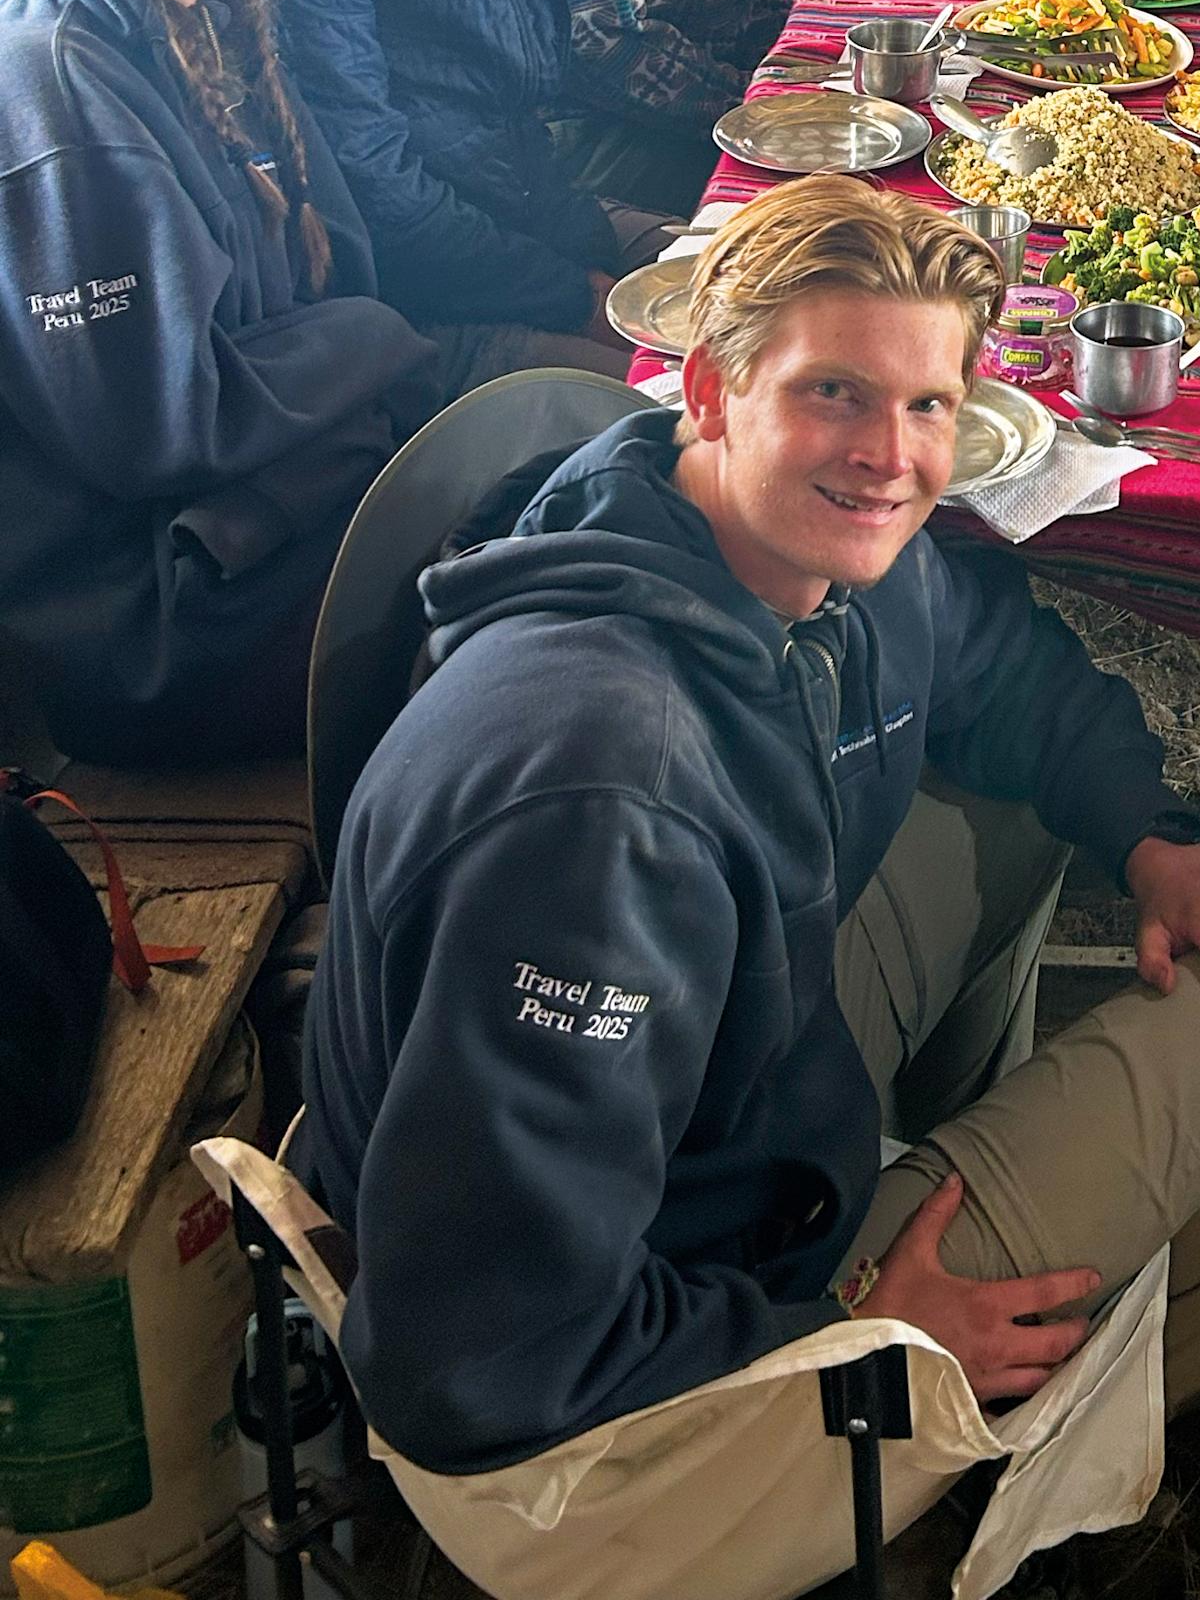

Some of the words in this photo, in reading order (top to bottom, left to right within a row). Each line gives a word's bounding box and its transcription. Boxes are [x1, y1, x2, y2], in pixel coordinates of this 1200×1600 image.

[25, 285, 81, 314] Travel
[86, 274, 138, 299] Team
[43, 312, 85, 331] Peru
[89, 294, 131, 320] 2025
[1003, 349, 1040, 364] COMPASS
[513, 961, 592, 1006] Travel
[600, 985, 650, 1013] Team
[516, 997, 576, 1033] Peru
[581, 1013, 633, 1040] 2025
